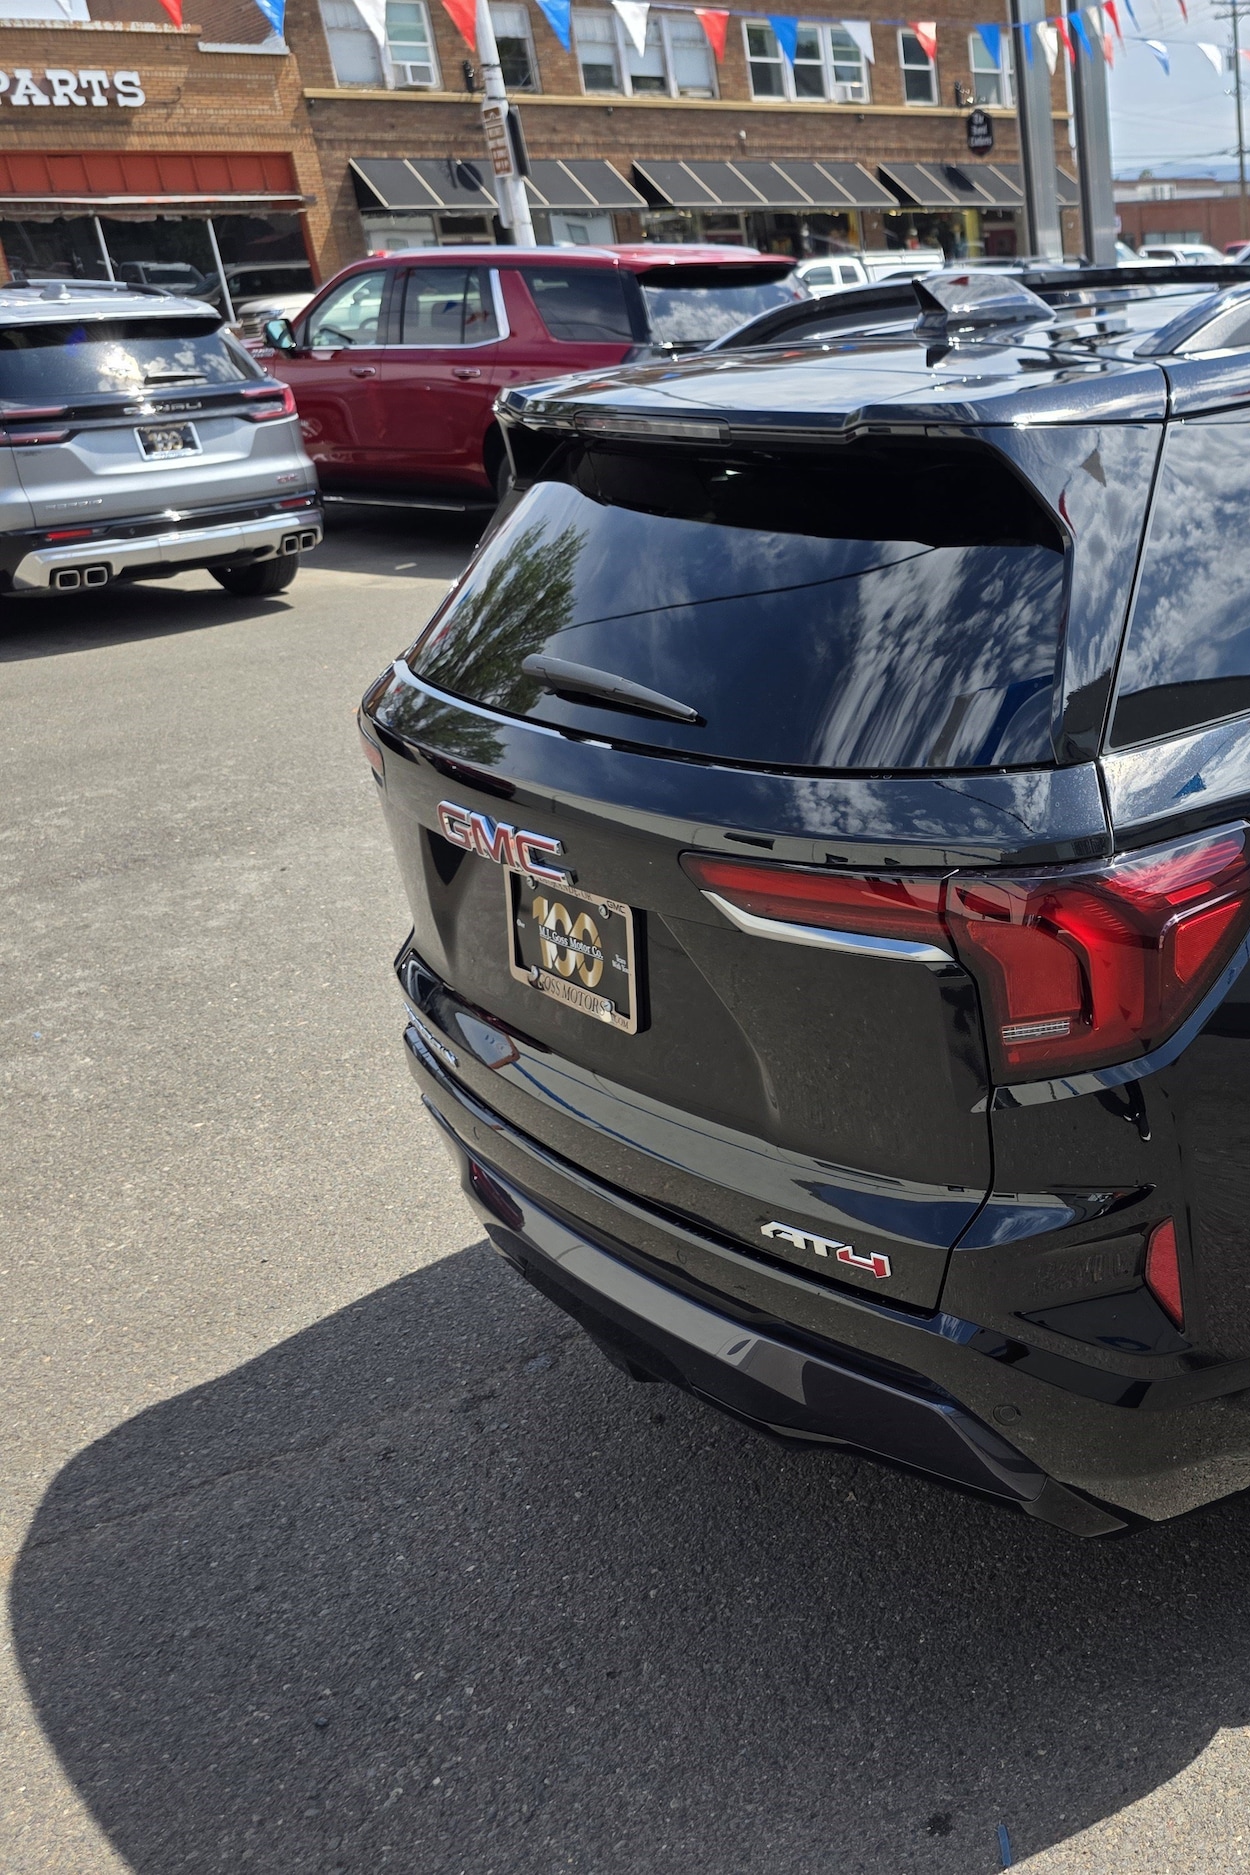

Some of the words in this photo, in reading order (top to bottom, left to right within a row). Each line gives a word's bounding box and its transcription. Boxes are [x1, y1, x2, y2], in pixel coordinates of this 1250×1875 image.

[437, 800, 577, 886] GMC
[606, 900, 627, 914] GMC
[532, 895, 604, 988] 100
[552, 931, 569, 946] Goss
[569, 936, 591, 953] Motor
[592, 944, 604, 959] Co.
[540, 973, 560, 996] GOSS
[561, 983, 605, 1016] MOTORS
[760, 1221, 892, 1278] AT4
